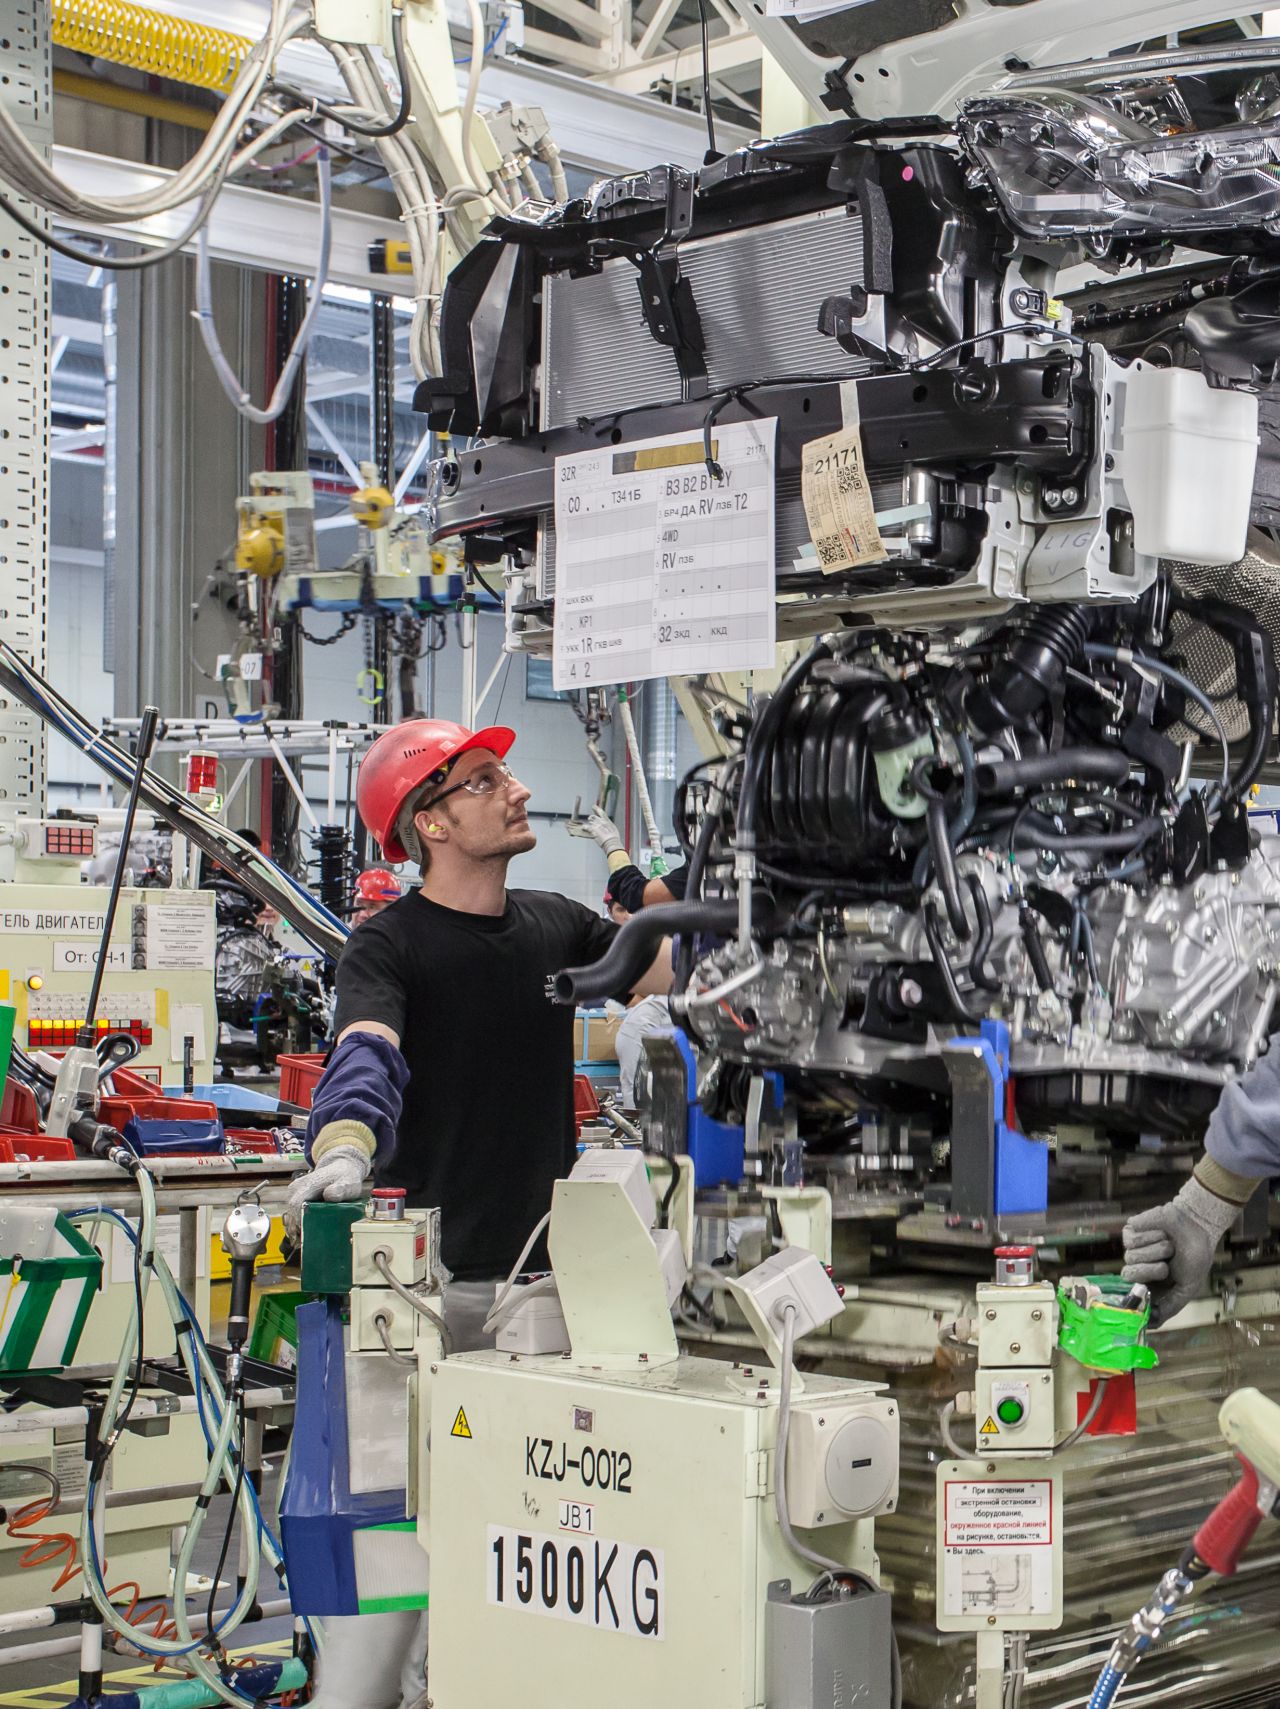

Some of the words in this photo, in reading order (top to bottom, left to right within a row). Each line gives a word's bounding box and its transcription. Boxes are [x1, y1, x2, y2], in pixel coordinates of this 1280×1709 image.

[814, 446, 858, 475] 21171
[561, 466, 576, 482] 3ZR
[666, 479, 680, 496] B3
[684, 476, 696, 494] B2
[680, 504, 696, 518] ДА
[699, 498, 714, 516] RV
[734, 492, 748, 510] T2
[662, 530, 678, 542] 4WD
[662, 552, 676, 569] RV
[658, 626, 672, 643] 32
[570, 664, 576, 679] 4
[584, 662, 591, 678] 2
[36, 914, 104, 930] ДВИГАТЕЛ
[65, 950, 88, 963] От:
[525, 1436, 632, 1494] KZJ-0012
[972, 1486, 986, 1495] При
[961, 1498, 1000, 1508] экстренной
[974, 1510, 1024, 1518] оборудование,
[950, 1522, 992, 1530] окруженное
[993, 1521, 1020, 1530] красной
[1022, 1520, 1046, 1528] линией
[966, 1534, 996, 1542] рисунке,
[492, 1534, 659, 1636] 1500KG
